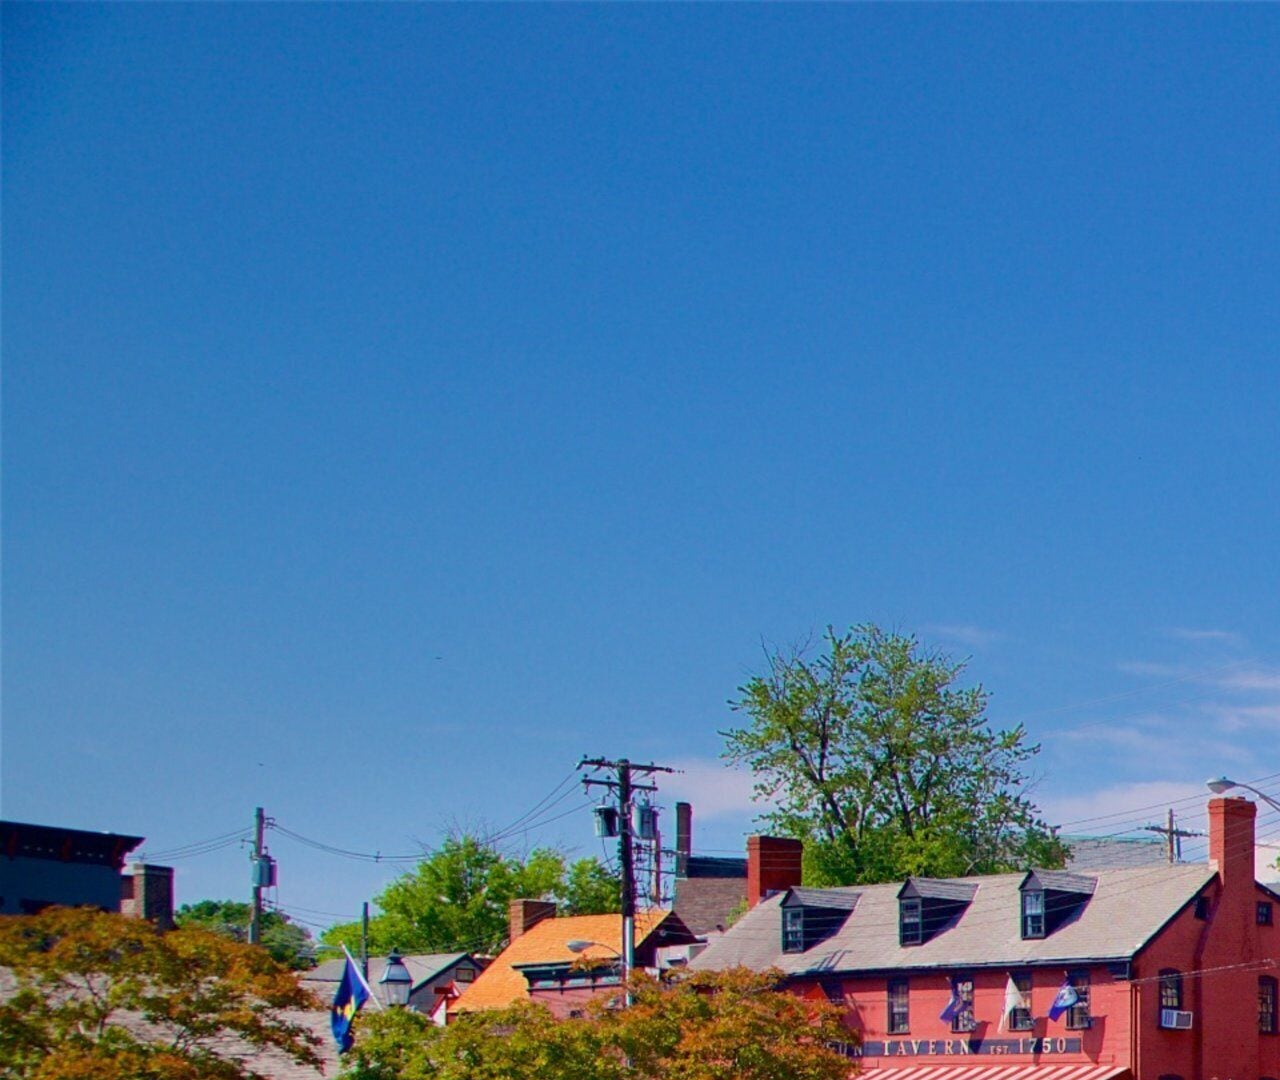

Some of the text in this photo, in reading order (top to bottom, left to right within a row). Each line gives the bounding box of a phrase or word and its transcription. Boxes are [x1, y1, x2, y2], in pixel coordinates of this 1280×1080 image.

[883, 1038, 970, 1056] TAVERN
[989, 1045, 1011, 1055] EST.
[1018, 1037, 1067, 1055] 1750
